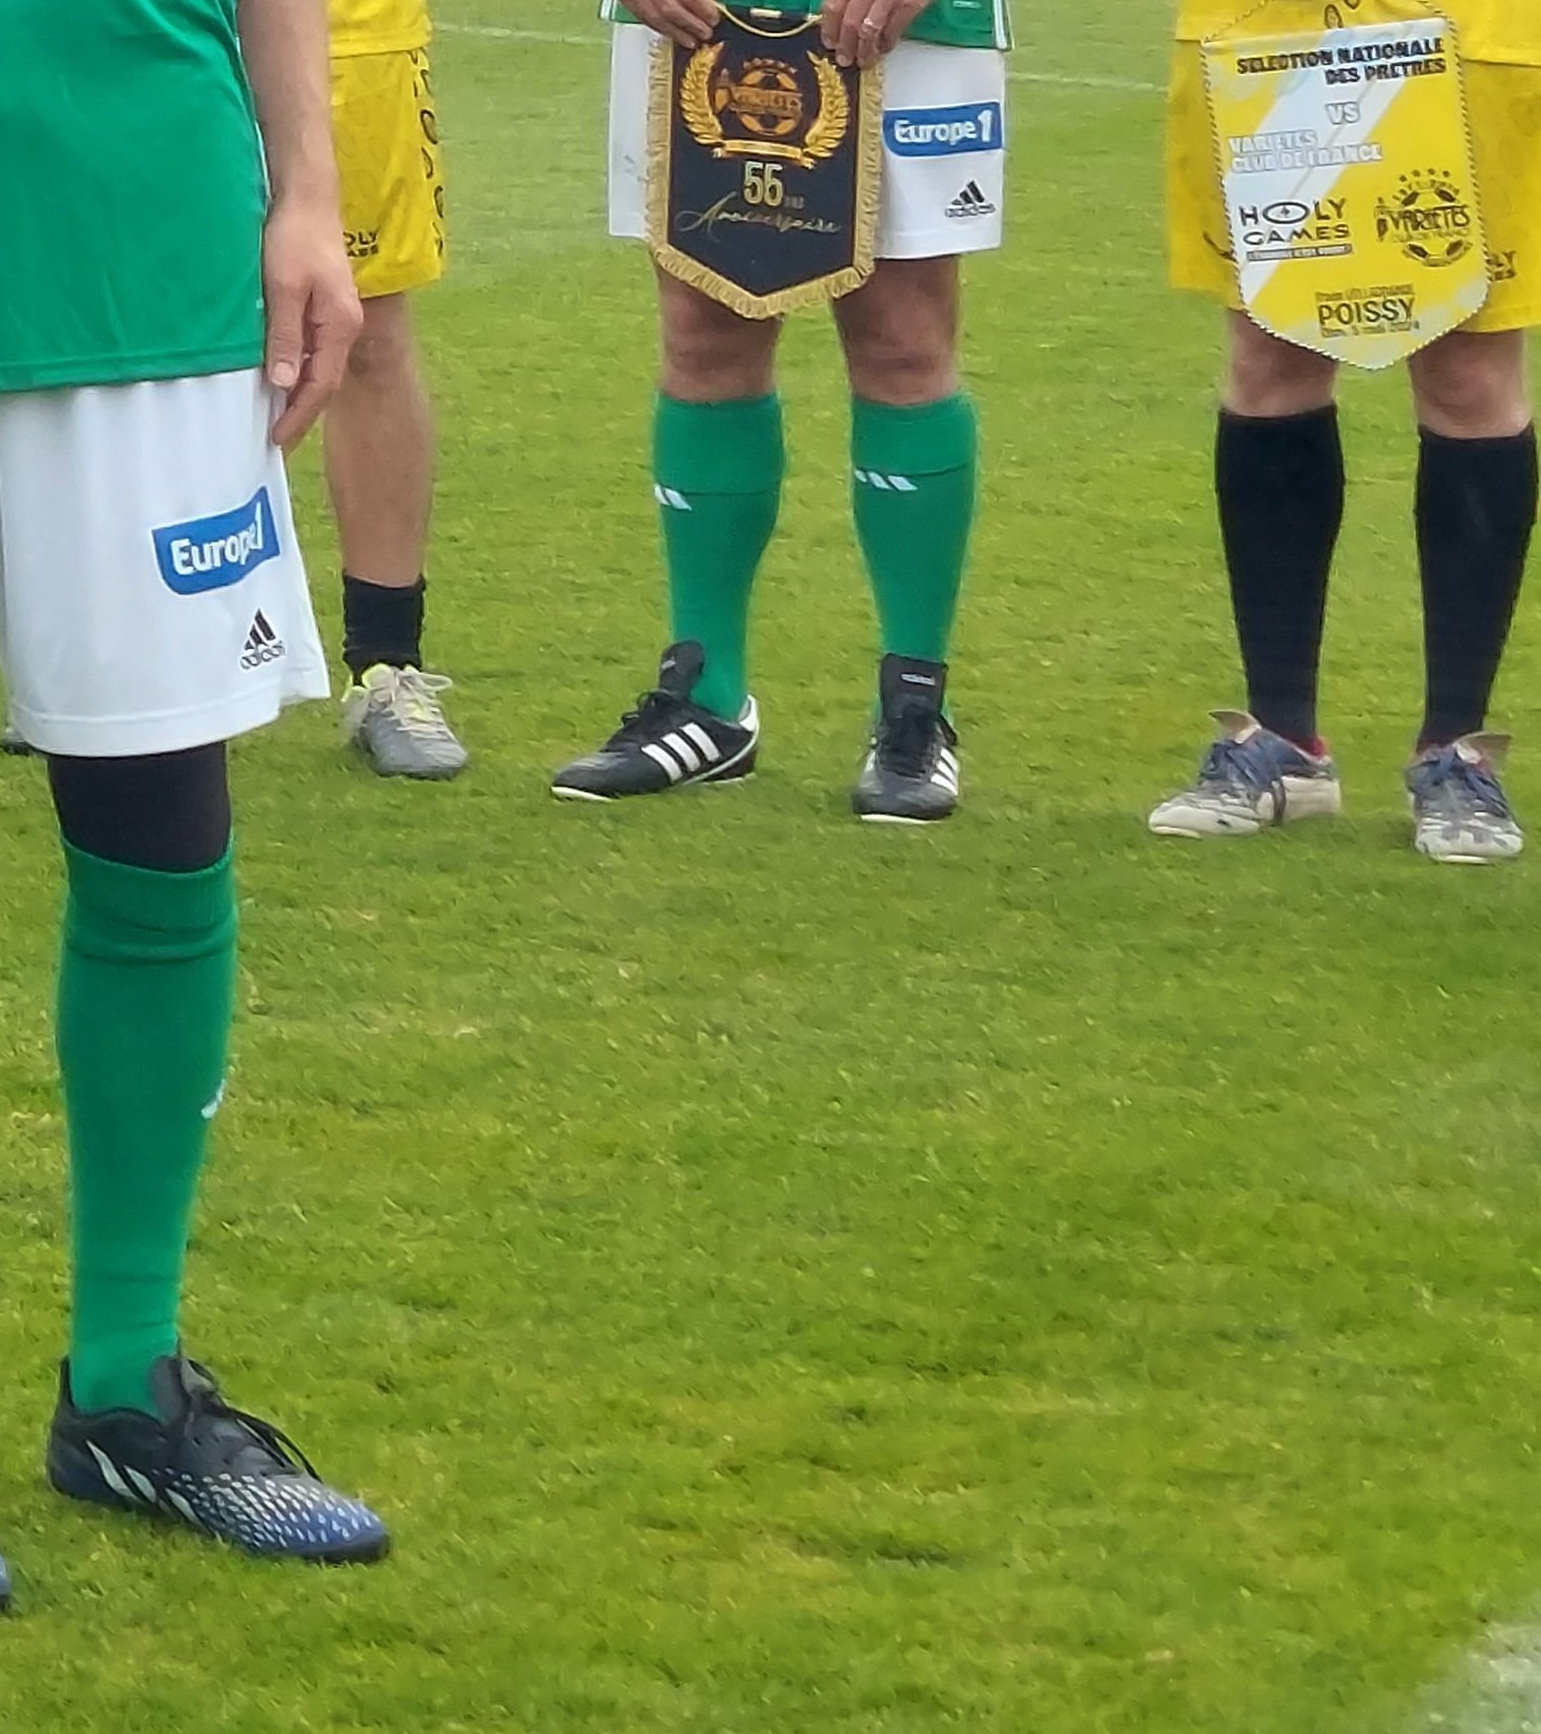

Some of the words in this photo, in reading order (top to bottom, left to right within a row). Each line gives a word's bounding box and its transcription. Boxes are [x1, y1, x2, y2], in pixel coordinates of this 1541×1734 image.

[1324, 101, 1360, 125] VS
[1239, 197, 1347, 227] HOLY
[1243, 223, 1350, 246] GAMES
[1319, 297, 1415, 326] POISSY
